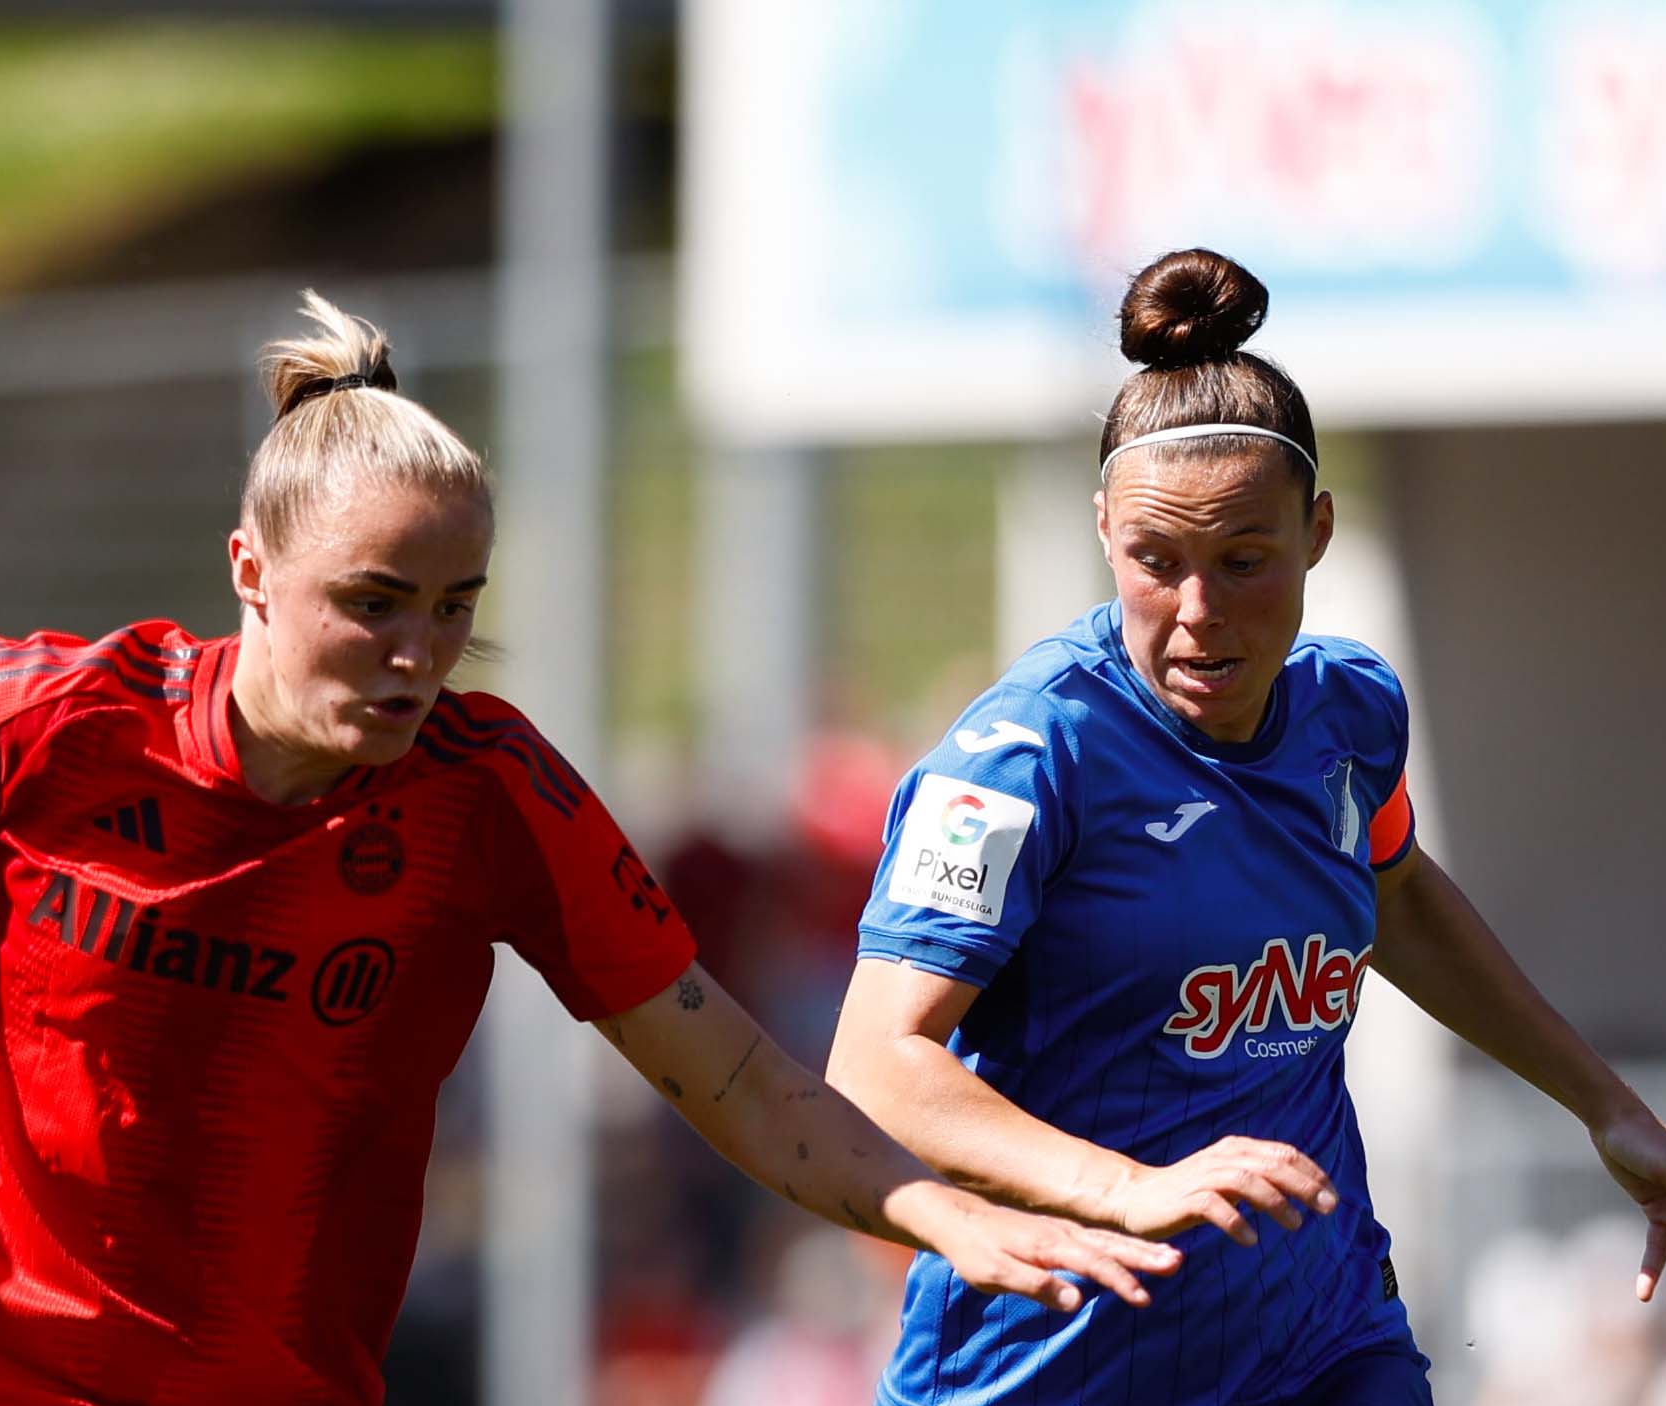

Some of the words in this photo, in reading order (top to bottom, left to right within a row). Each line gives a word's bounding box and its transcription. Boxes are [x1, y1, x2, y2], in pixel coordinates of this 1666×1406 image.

[914, 849, 988, 894] Pixel
[931, 891, 992, 916] BUNDESLIGA
[28, 872, 297, 1002] Allianz
